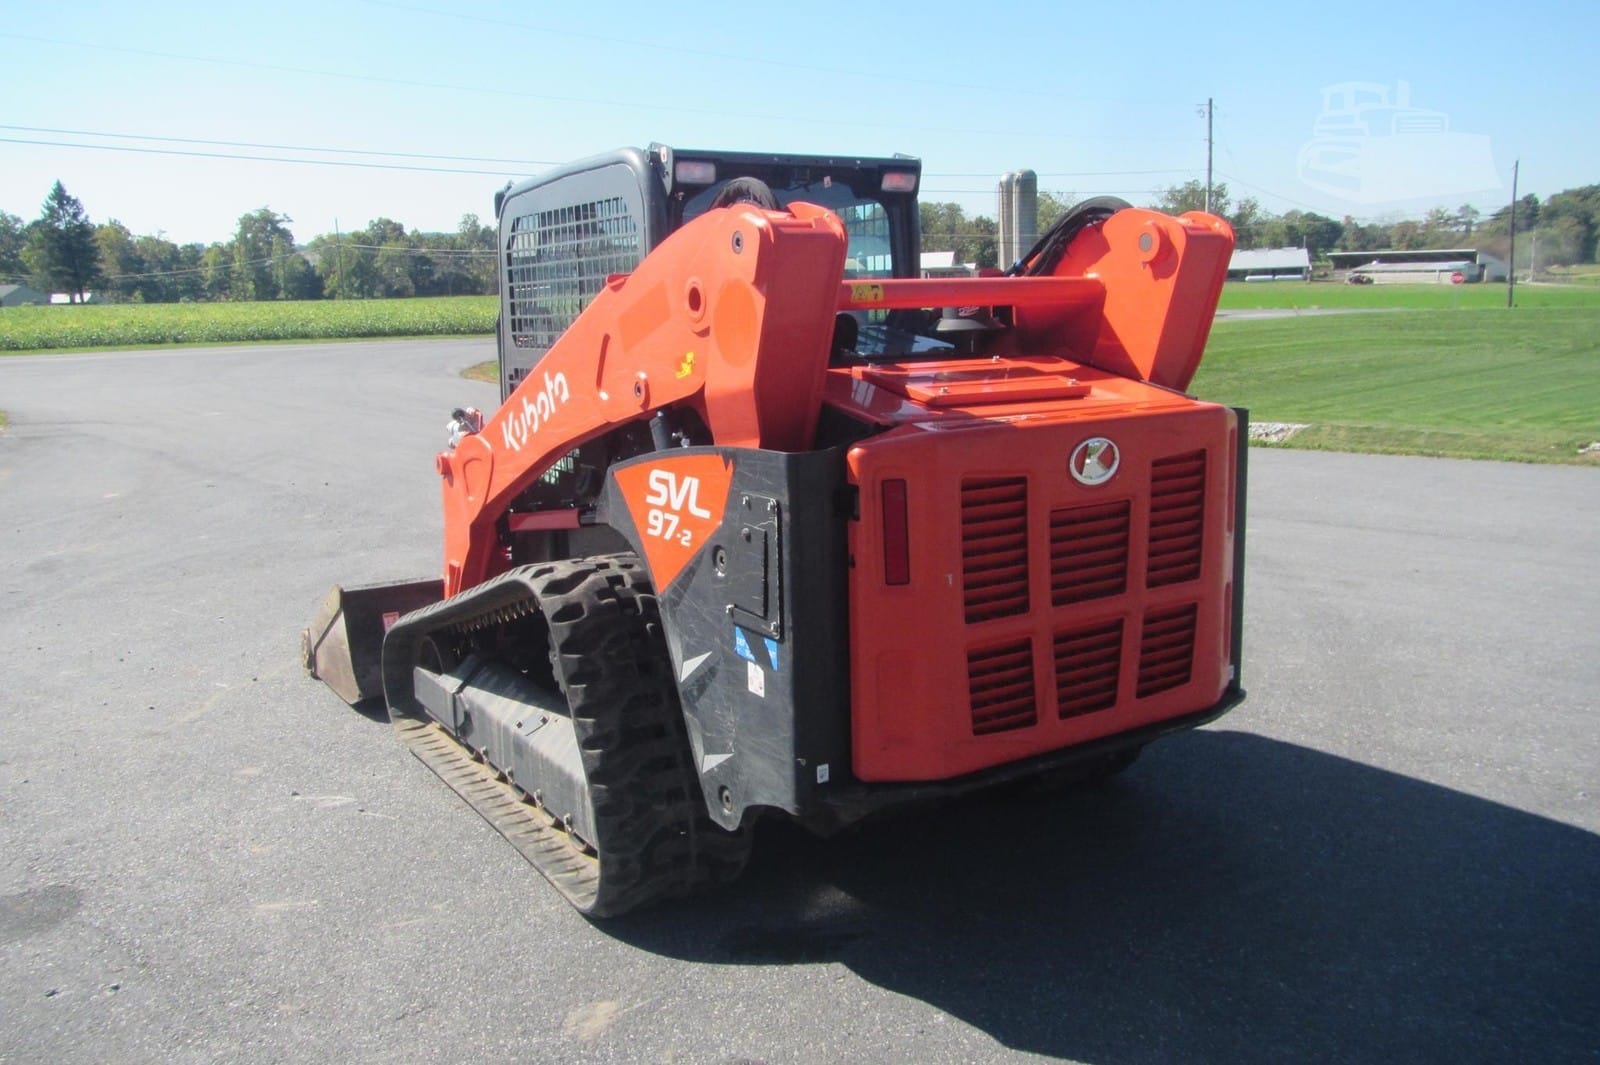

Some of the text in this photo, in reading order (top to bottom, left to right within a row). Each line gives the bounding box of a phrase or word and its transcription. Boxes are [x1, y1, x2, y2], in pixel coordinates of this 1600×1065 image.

[501, 371, 569, 451] Kubota
[645, 469, 711, 519] SVL
[647, 509, 692, 547] 97-2
